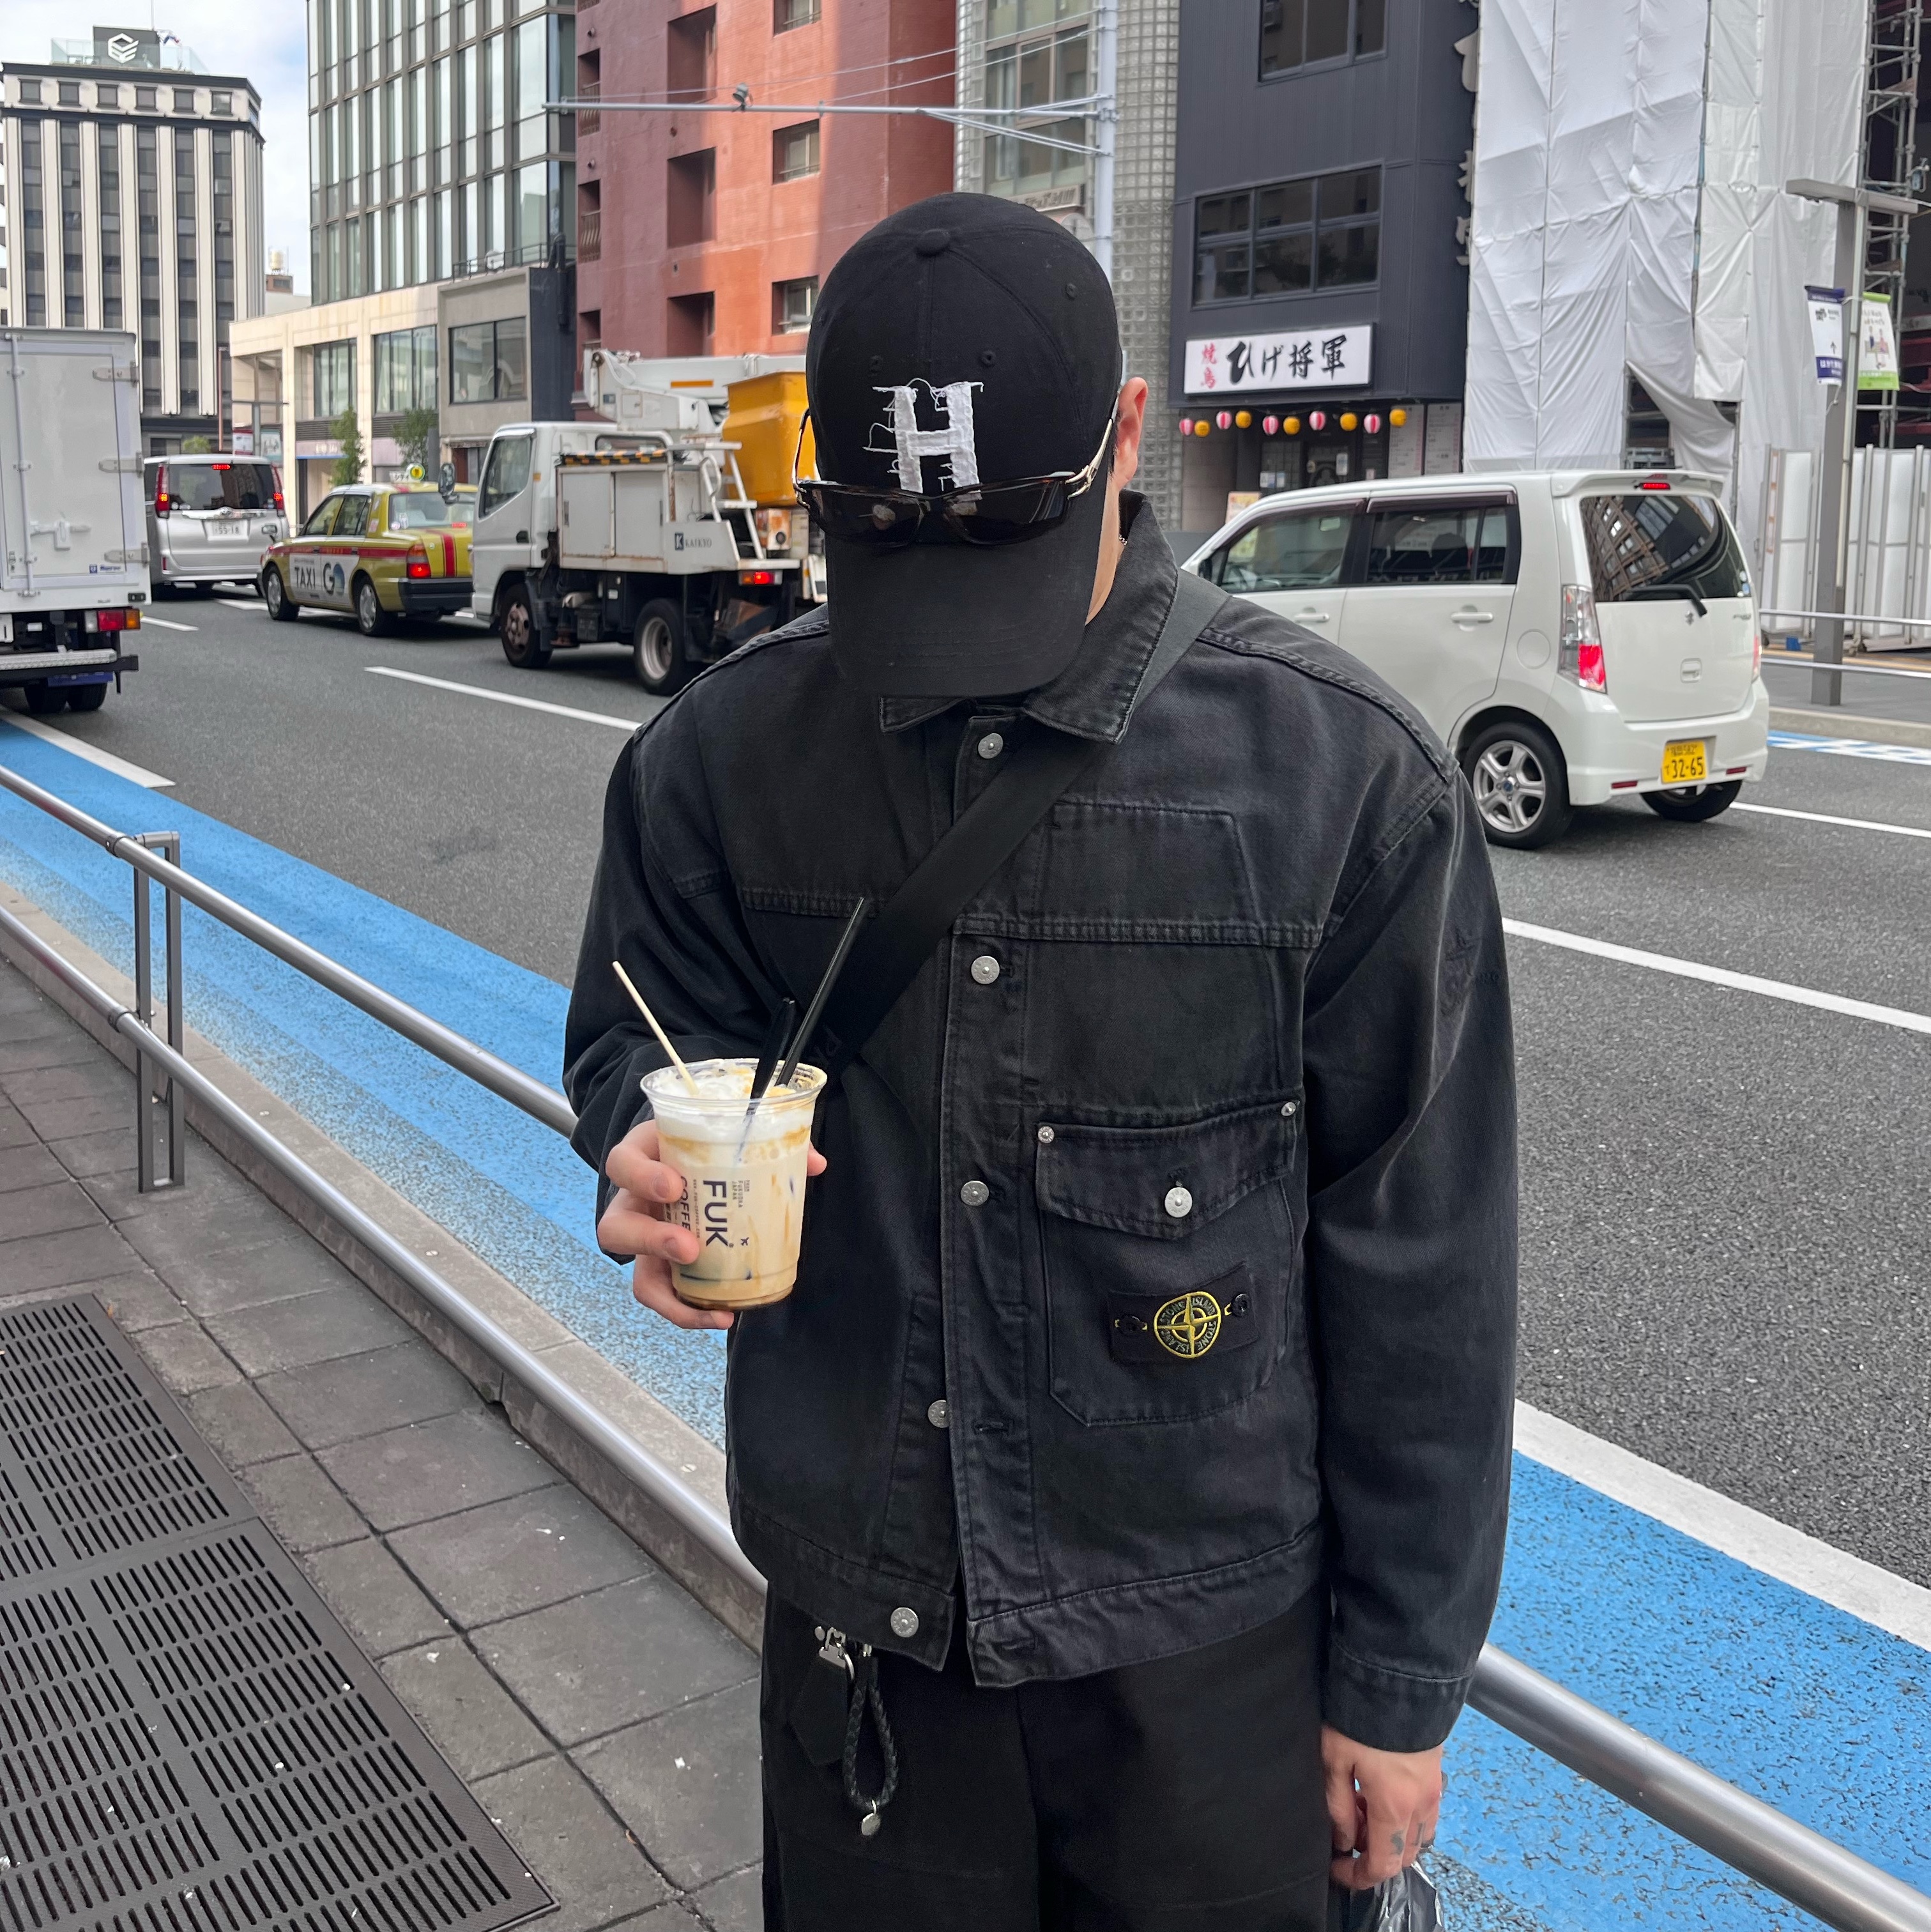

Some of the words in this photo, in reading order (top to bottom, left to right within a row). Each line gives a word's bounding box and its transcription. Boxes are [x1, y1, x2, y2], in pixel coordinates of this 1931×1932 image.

[1226, 334, 1347, 385] ひげ将軍
[864, 378, 984, 494] H
[685, 538, 712, 548] KAIKYO
[294, 566, 316, 590] TAXI
[323, 562, 346, 596] GO
[1672, 756, 1704, 779] 32-65
[680, 1176, 691, 1231] COFFE
[703, 1180, 729, 1247] FUK
[1194, 1321, 1217, 1351] STONE
